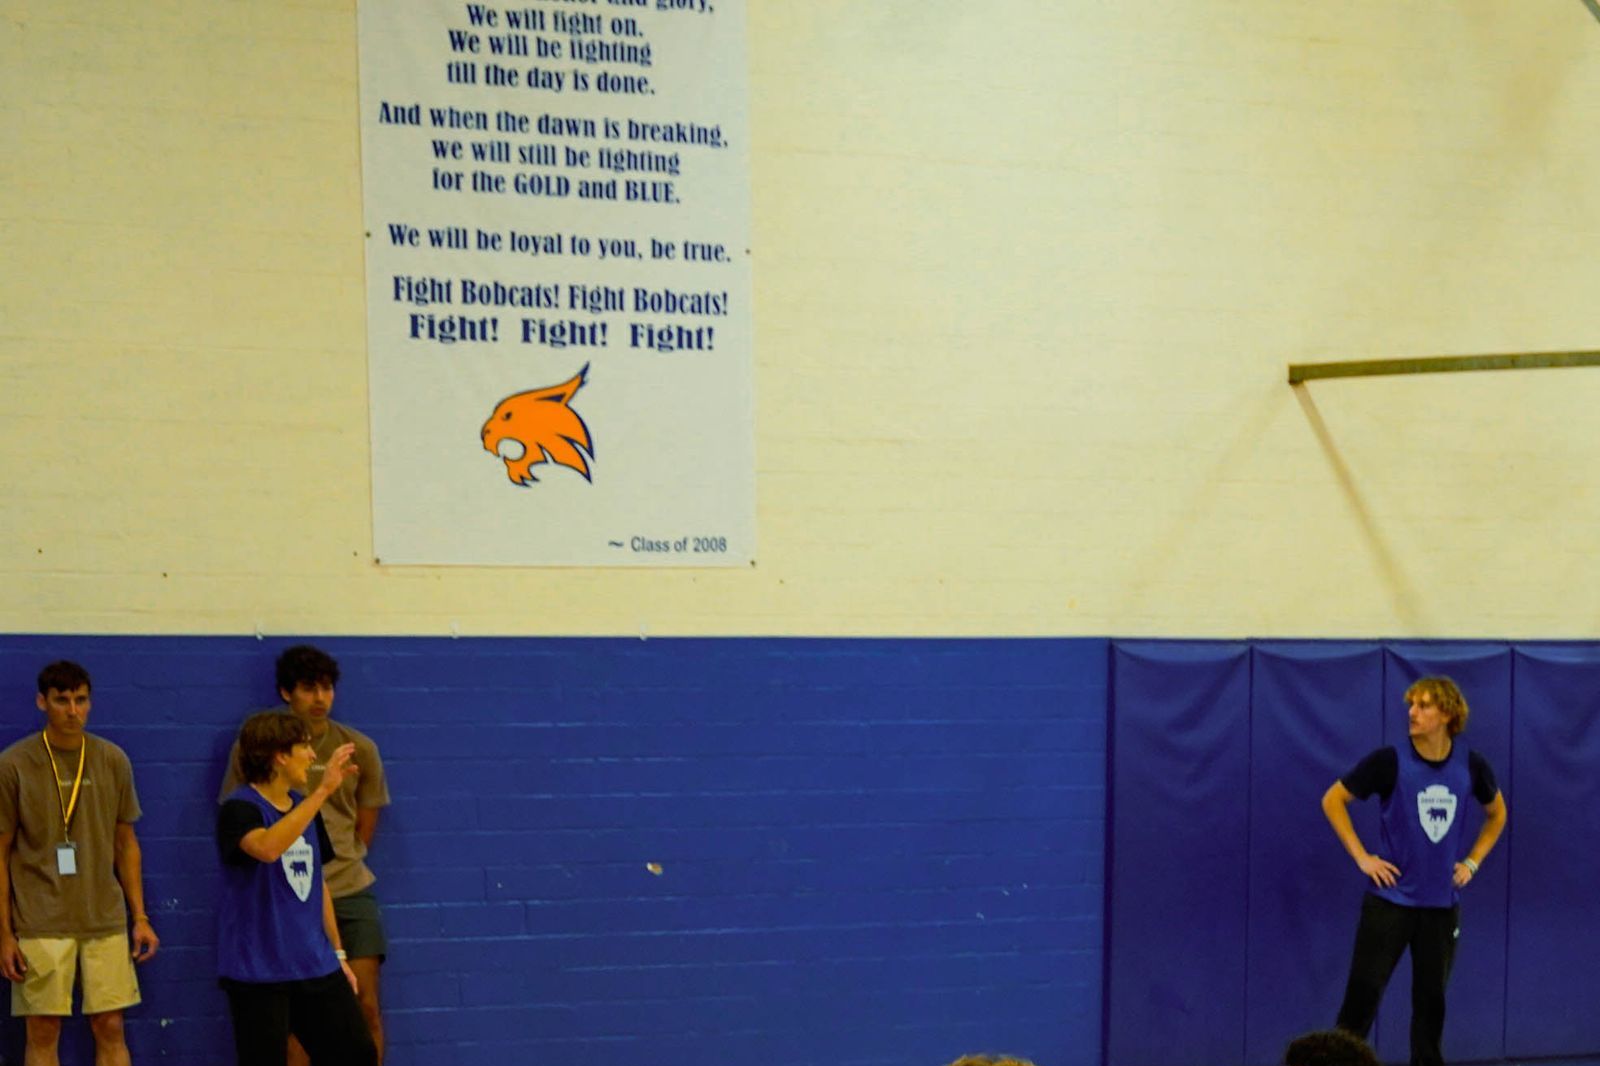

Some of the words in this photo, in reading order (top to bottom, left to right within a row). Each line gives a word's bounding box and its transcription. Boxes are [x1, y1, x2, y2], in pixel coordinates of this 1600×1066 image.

[466, 4, 498, 27] We
[505, 9, 544, 31] will
[553, 12, 601, 36] fight
[611, 18, 643, 38] on.
[448, 29, 480, 53] We
[489, 34, 528, 57] will
[537, 36, 562, 58] be
[570, 39, 652, 67] fighting
[447, 61, 476, 84] till
[485, 64, 519, 87] the
[527, 67, 565, 93] day
[573, 69, 589, 91] is
[596, 72, 655, 95] done.
[379, 101, 421, 126] And
[429, 105, 488, 131] when
[496, 111, 529, 133] the
[537, 114, 596, 138] dawn
[604, 117, 620, 139] is
[628, 119, 728, 148] breaking,
[471, 141, 510, 163] will
[518, 144, 557, 166] still
[565, 146, 590, 168] be
[598, 149, 680, 176] fighting
[432, 167, 464, 192] for
[472, 170, 505, 193] the
[514, 173, 570, 197] GOLD
[578, 179, 617, 201] and
[626, 181, 680, 204] BLUE.
[388, 224, 420, 248] We
[428, 226, 468, 251] will
[476, 229, 502, 252] be
[510, 231, 563, 256] loyal
[571, 234, 591, 256] to
[598, 238, 642, 260] you,
[651, 238, 676, 261] be
[683, 240, 731, 263] true.
[393, 276, 452, 305] Fight
[461, 280, 559, 309] Bobcats!
[568, 284, 625, 315] Fight
[633, 288, 729, 316] Bobcats!
[409, 314, 499, 343] Fight!
[521, 318, 607, 347] Fight!
[630, 323, 714, 352] Fight!
[630, 536, 669, 552] Class
[674, 536, 687, 552] of
[693, 536, 727, 553] 2008
